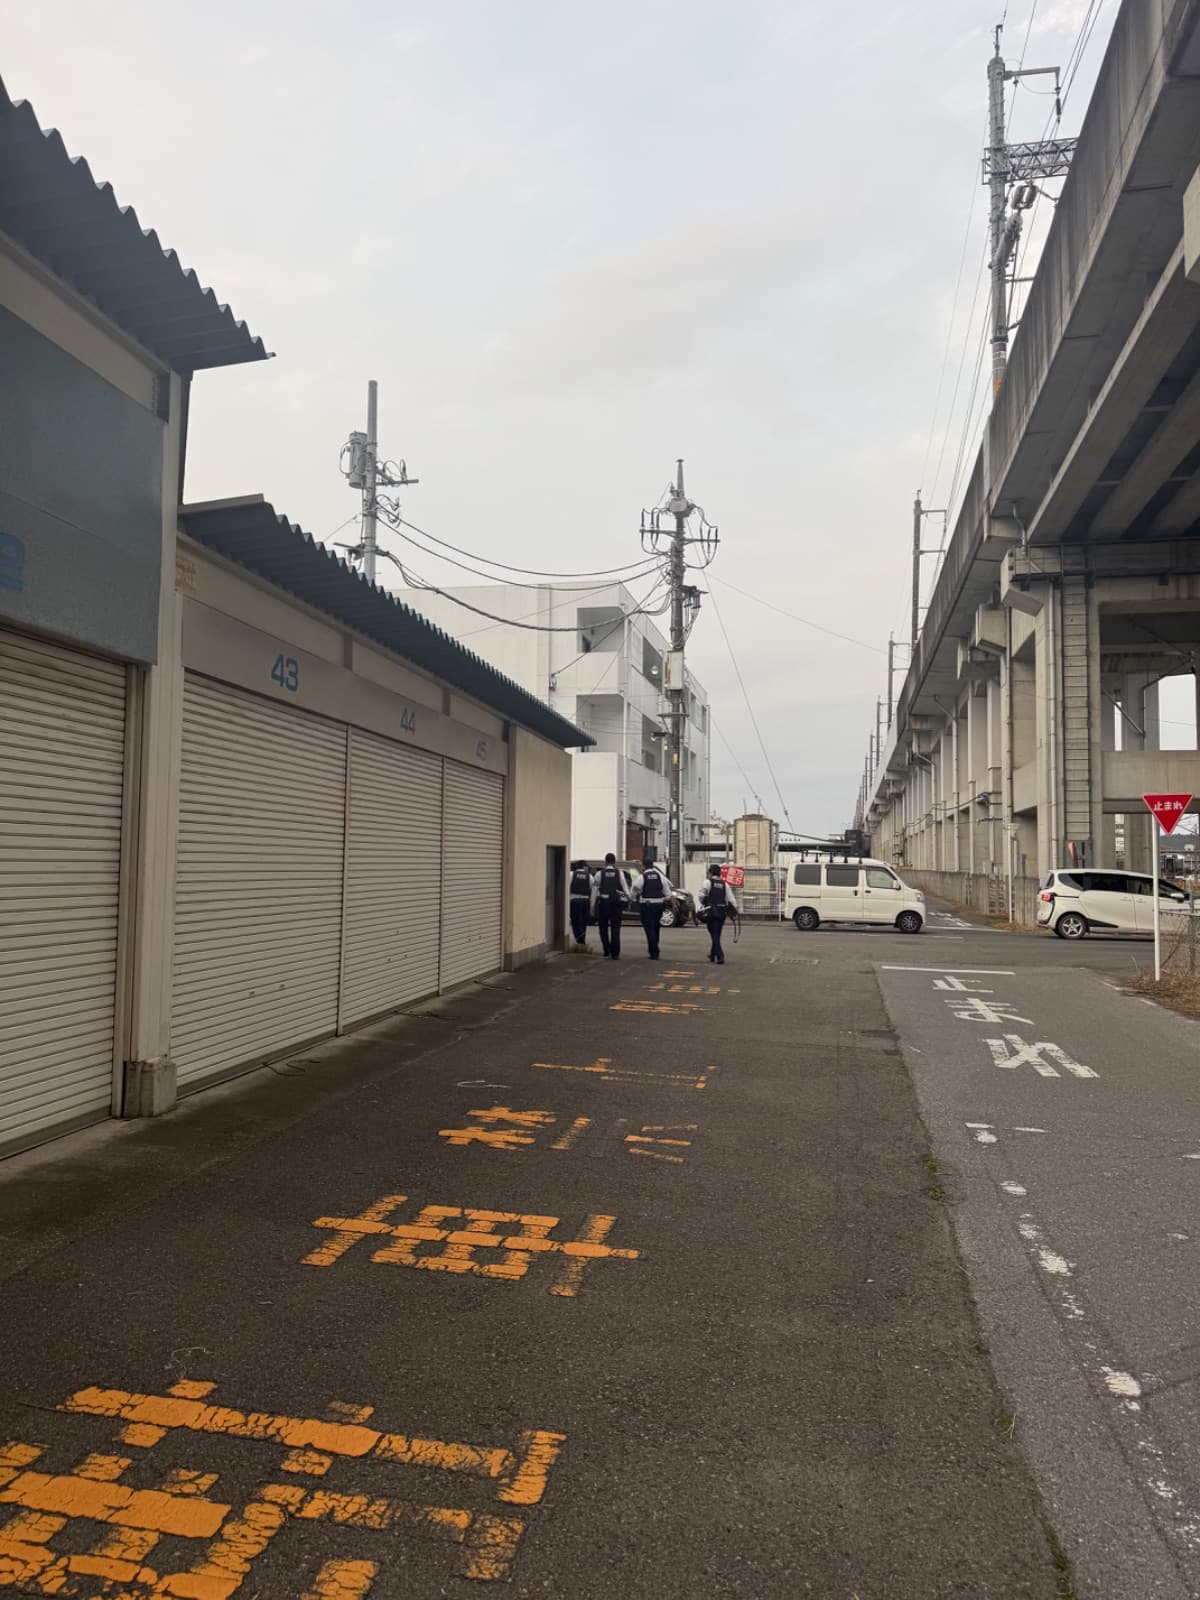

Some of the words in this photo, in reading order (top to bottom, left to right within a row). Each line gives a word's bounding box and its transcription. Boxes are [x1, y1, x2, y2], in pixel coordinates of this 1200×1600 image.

[271, 654, 299, 692] 43
[400, 707, 416, 736] 44
[475, 741, 488, 762] 45
[1153, 801, 1184, 811] 止まれ
[932, 975, 1101, 1078] 止まれ
